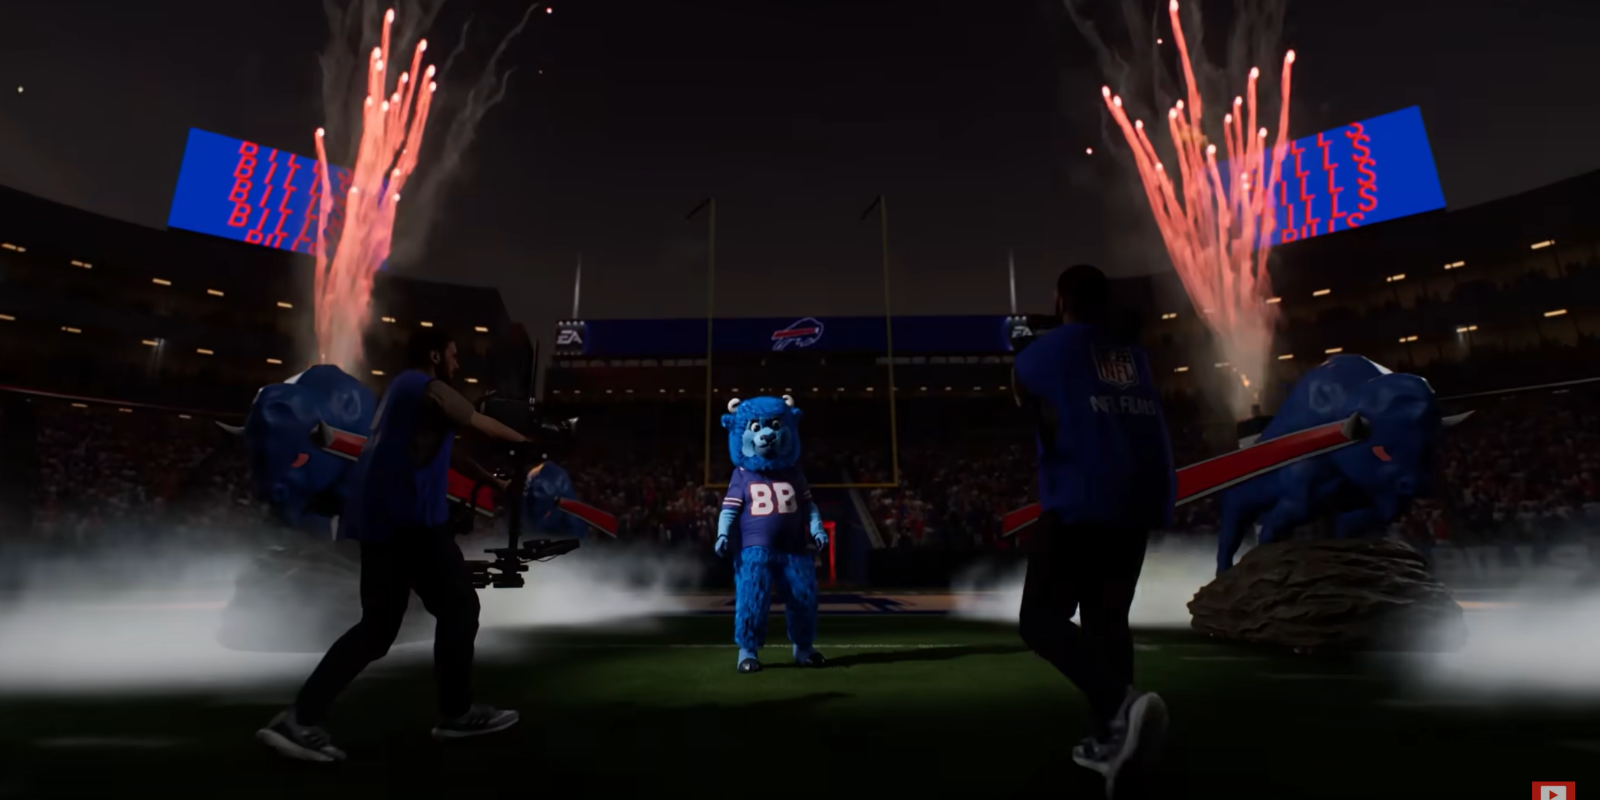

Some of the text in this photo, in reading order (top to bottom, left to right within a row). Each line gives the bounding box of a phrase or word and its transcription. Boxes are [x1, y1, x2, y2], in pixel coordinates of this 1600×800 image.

[1275, 133, 1371, 183] ILLS
[1280, 156, 1377, 207] ILLS
[556, 329, 583, 345] EA
[1101, 362, 1136, 383] NFL
